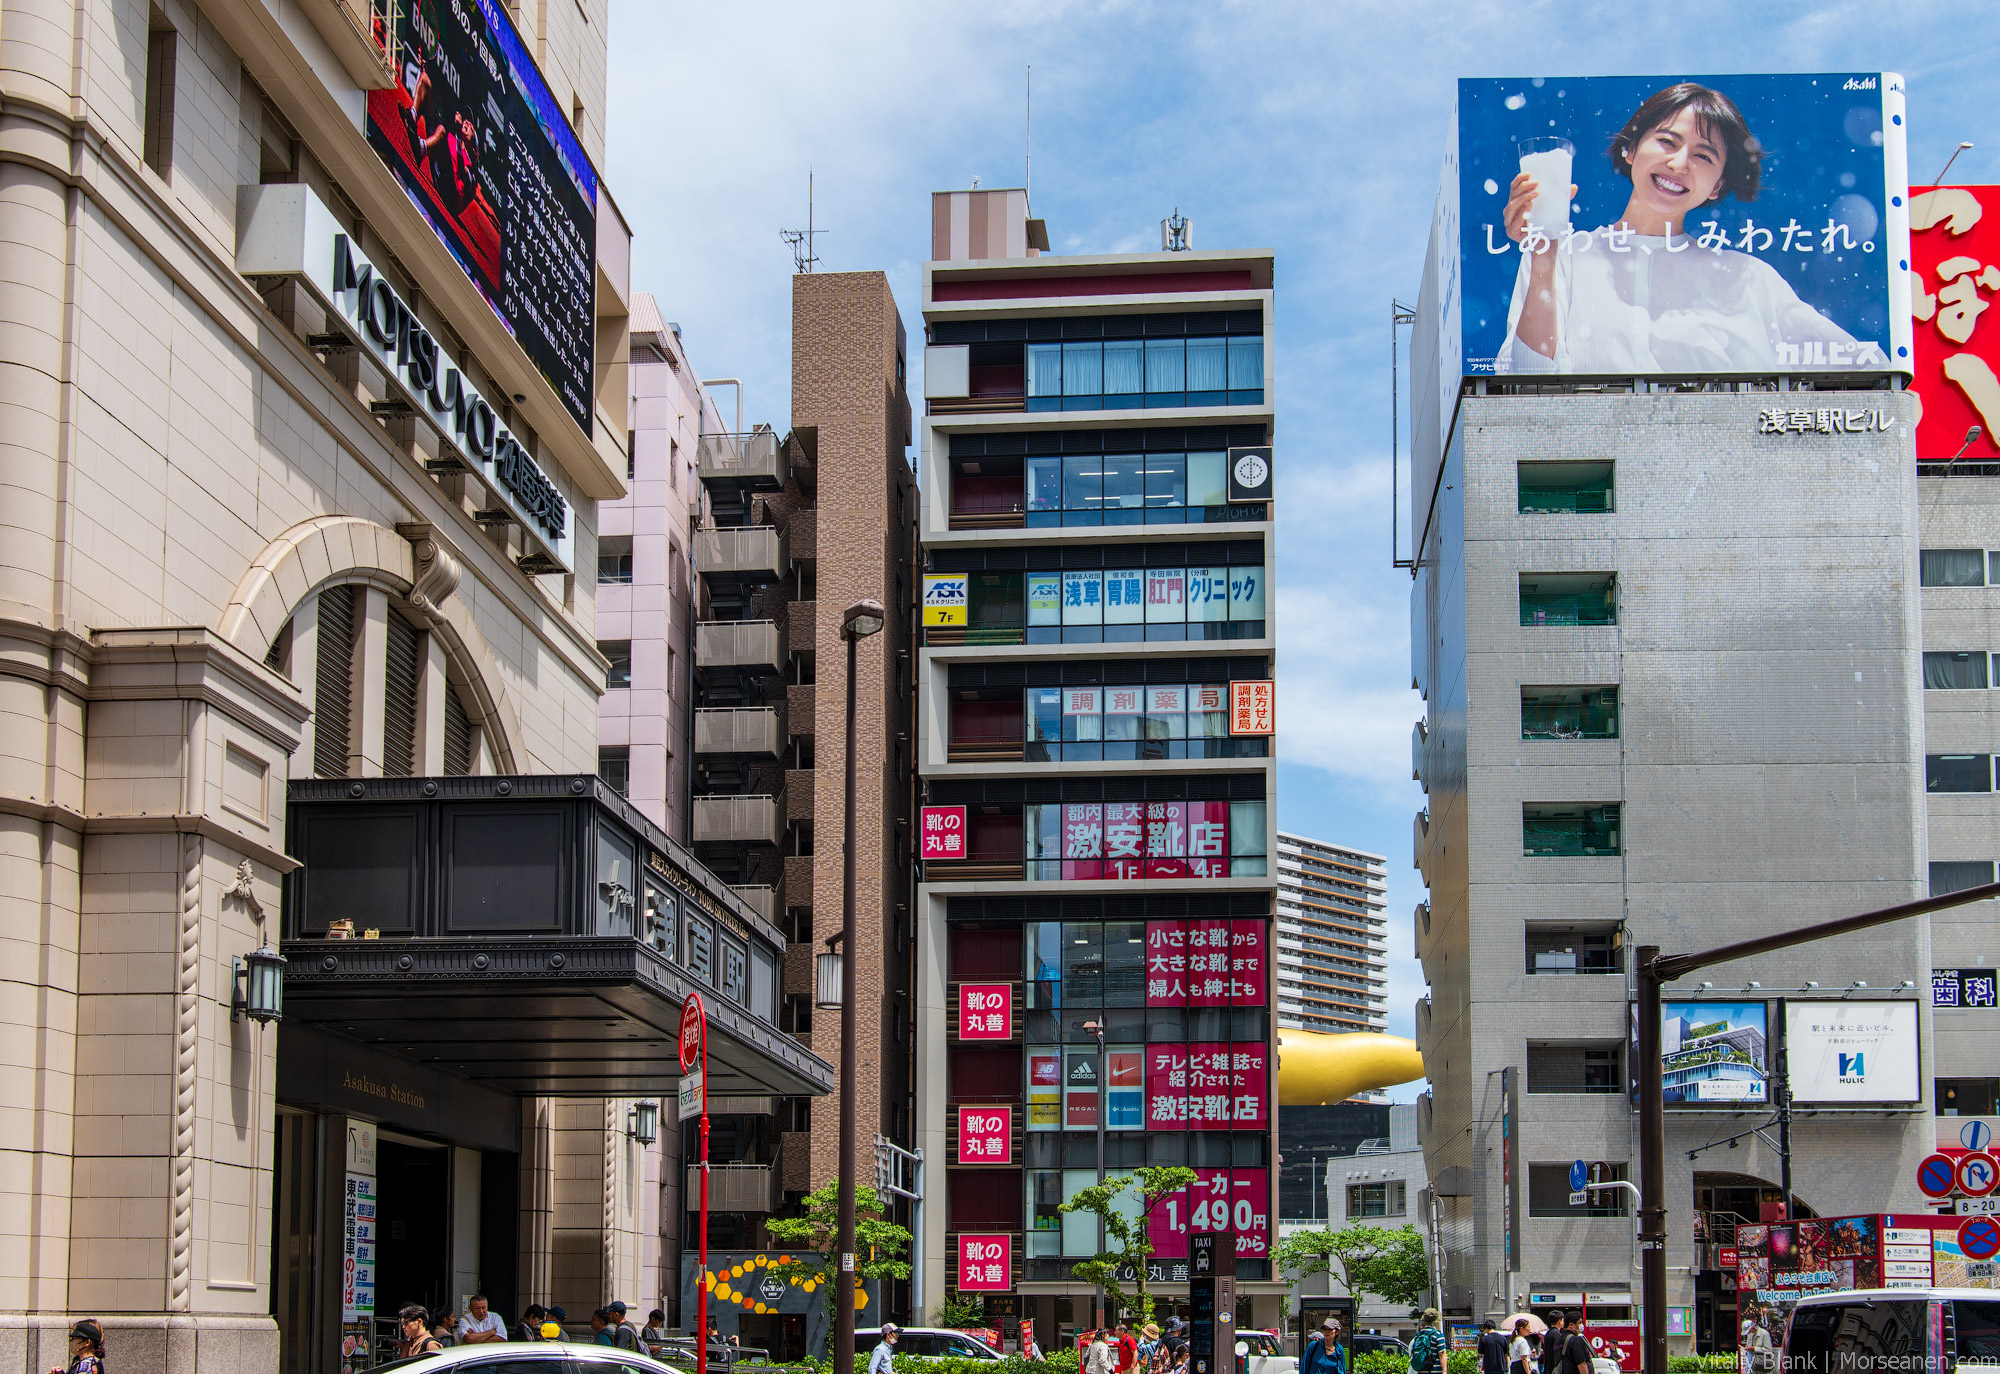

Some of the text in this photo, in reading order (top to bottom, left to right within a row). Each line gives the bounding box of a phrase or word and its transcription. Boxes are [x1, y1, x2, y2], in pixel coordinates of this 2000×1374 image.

[1843, 76, 1876, 90] Asahi
[1485, 218, 1876, 257] しあわせ、しみわたれ。
[1775, 340, 1880, 367] カルピス
[1471, 363, 1510, 371] アサヒ飲料
[1759, 407, 1896, 435] 浅草駅ビル
[493, 430, 567, 540] 松屋浅草
[926, 582, 965, 598] ASK
[938, 611, 954, 622] 7F
[1238, 685, 1251, 730] 調剤薬局
[1254, 685, 1268, 730] 処方せん
[926, 814, 961, 830] 靴の
[926, 834, 962, 851] 丸善
[1066, 820, 1225, 857] 激安靴店
[1149, 928, 1258, 948] 小さな靴から
[645, 888, 746, 1007] 浅草駅
[1149, 954, 1258, 972] 大きな靴まで
[1149, 978, 1256, 998] 婦人も紳士も
[1932, 978, 1995, 1006] 歯科
[967, 992, 1003, 1009] 靴の
[967, 1014, 1004, 1031] 丸善
[1168, 1070, 1246, 1088] 紹介された
[343, 1069, 425, 1109] Asakusa Station
[1151, 1096, 1259, 1122] 激安靴店
[966, 1115, 1003, 1133] 靴の
[966, 1137, 1003, 1155] 丸善
[357, 1180, 370, 1194] 日光
[357, 1225, 369, 1238] 会津
[345, 1178, 357, 1305] 東武電車のりば
[1194, 1237, 1212, 1248] TAXI
[1235, 1235, 1265, 1252] から
[965, 1242, 1002, 1260] 靴の
[356, 1269, 368, 1281] 太田
[965, 1264, 1003, 1282] 丸善
[1776, 1271, 1838, 1285] ようこそ台東区へ
[1757, 1289, 1800, 1302] Welcome
